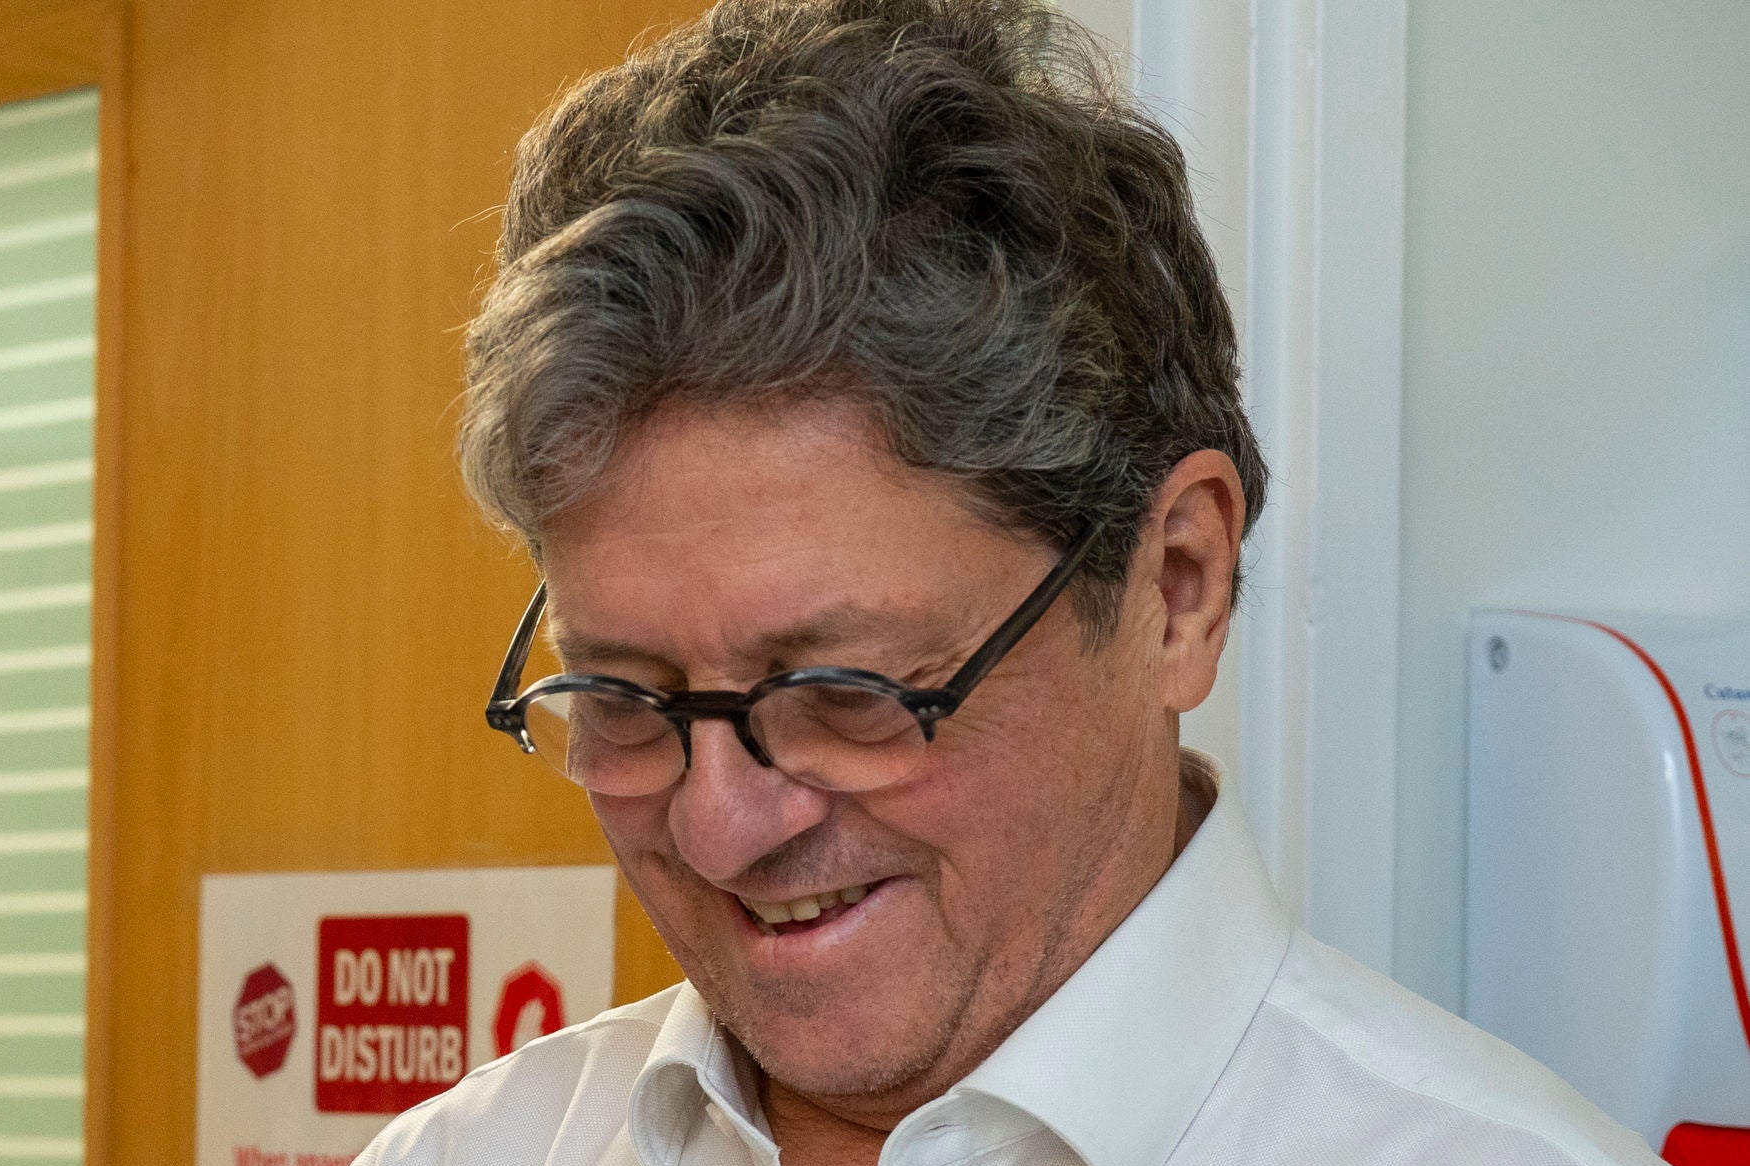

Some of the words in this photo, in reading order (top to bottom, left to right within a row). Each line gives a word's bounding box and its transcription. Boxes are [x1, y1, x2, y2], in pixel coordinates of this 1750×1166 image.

[333, 948, 383, 1007] DO
[388, 948, 455, 1007] NOT
[235, 985, 293, 1039] STOP
[320, 1025, 463, 1082] DISTURB
